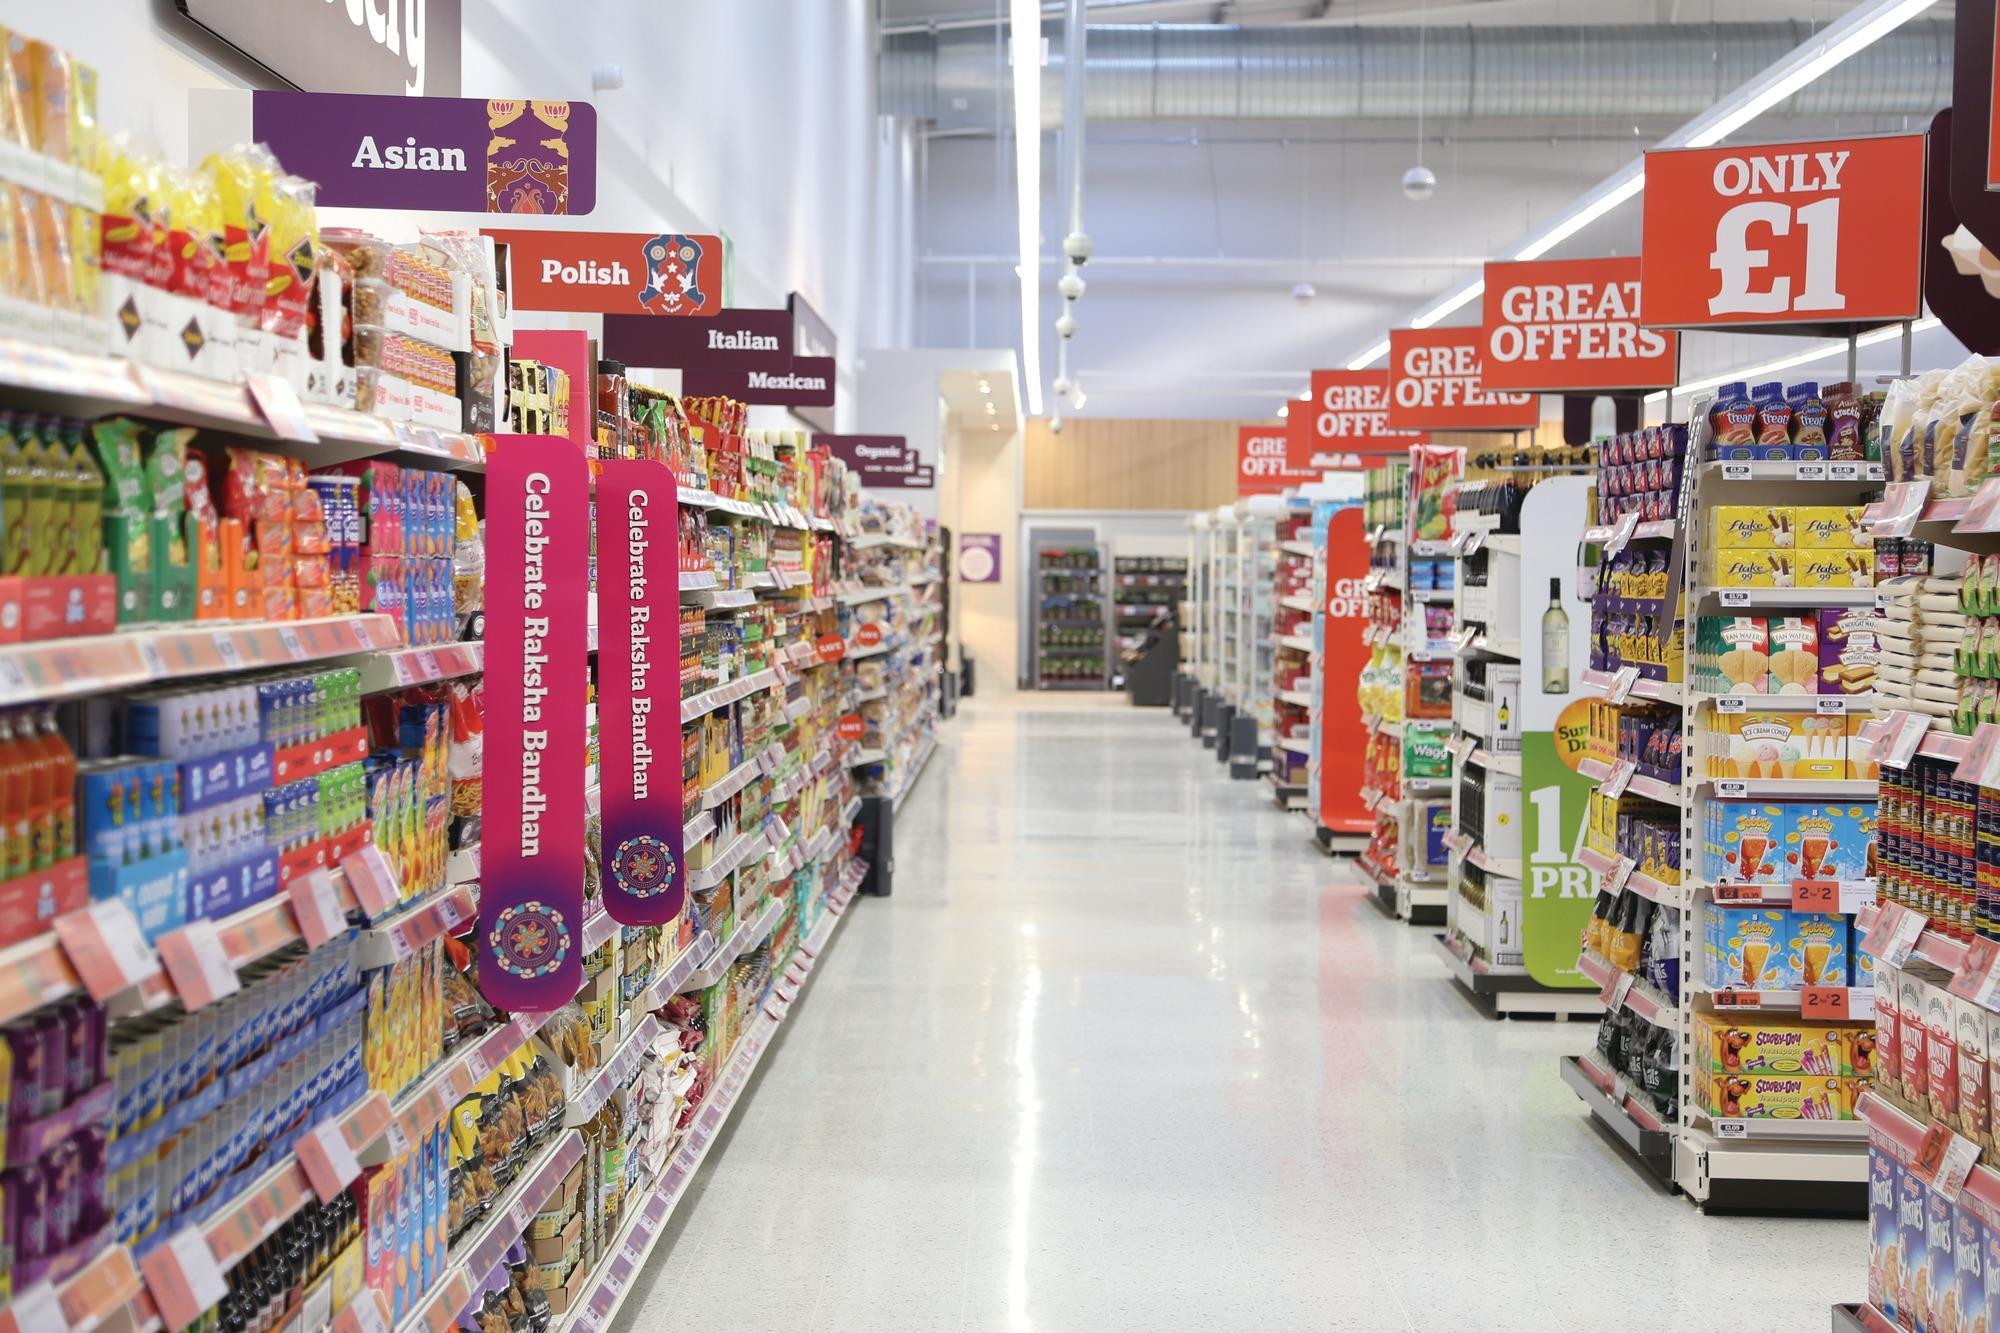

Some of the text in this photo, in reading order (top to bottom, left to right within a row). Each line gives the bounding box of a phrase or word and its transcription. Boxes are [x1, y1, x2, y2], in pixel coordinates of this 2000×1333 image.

[351, 135, 467, 172] Asian
[1713, 150, 1850, 196] ONLY
[1708, 197, 1845, 316] £1
[541, 259, 630, 286] Polish
[708, 330, 779, 351] Italian
[1490, 322, 1667, 362] OFFERS
[748, 371, 826, 391] Mexican
[855, 444, 901, 460] Organic
[1741, 573, 1753, 581] 99
[1819, 573, 1831, 581] 99
[1726, 632, 1763, 641] FAN WAFERS
[1776, 632, 1812, 641] FAN WAFERS
[627, 489, 653, 801] Celebrate Raksha Bandhan
[521, 472, 550, 858] Celebrate Raksha Bandhan
[1744, 727, 1787, 736] ICE CREAM CONES
[1414, 744, 1447, 760] Wagg
[1812, 808, 1818, 816] 8
[1799, 887, 1808, 899] 2
[1752, 913, 1758, 921] 8
[1809, 994, 1818, 1006] 2
